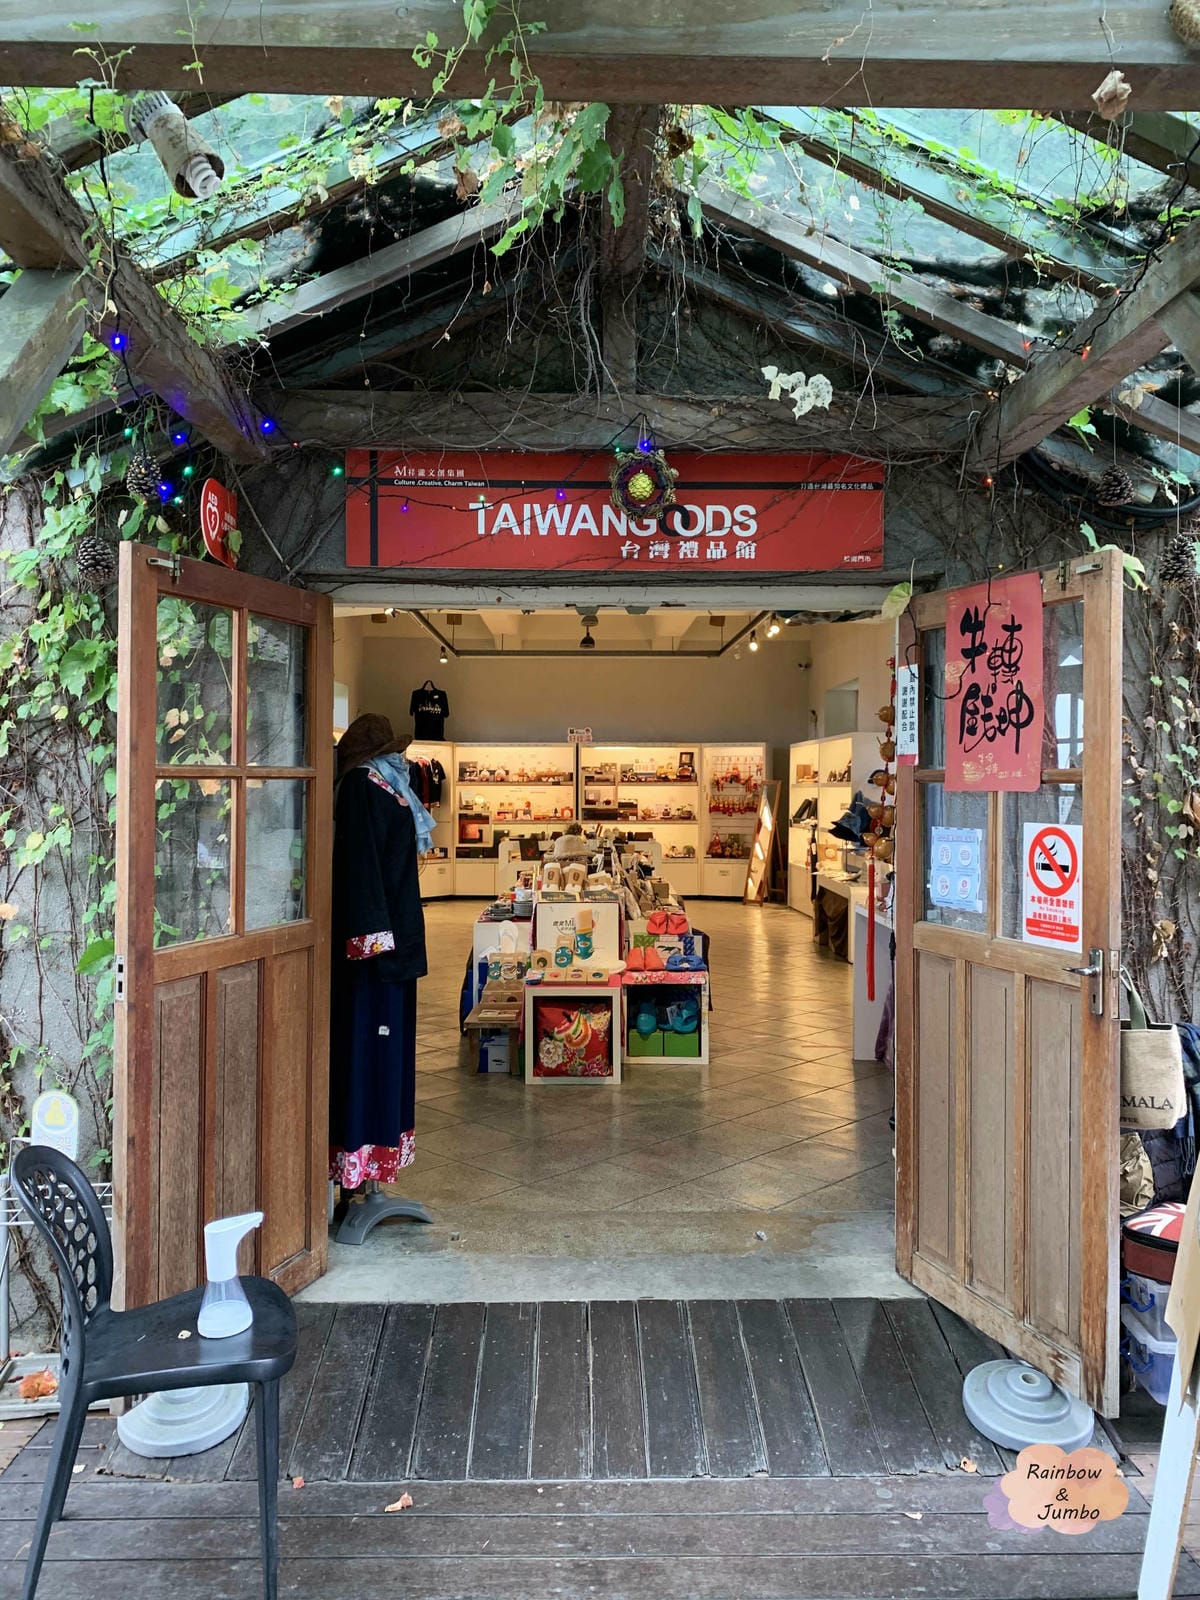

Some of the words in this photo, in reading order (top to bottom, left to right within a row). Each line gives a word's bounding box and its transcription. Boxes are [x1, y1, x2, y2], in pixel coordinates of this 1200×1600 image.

[468, 503, 758, 537] TAIWANGOODS
[620, 540, 757, 559] 台灣禮品館
